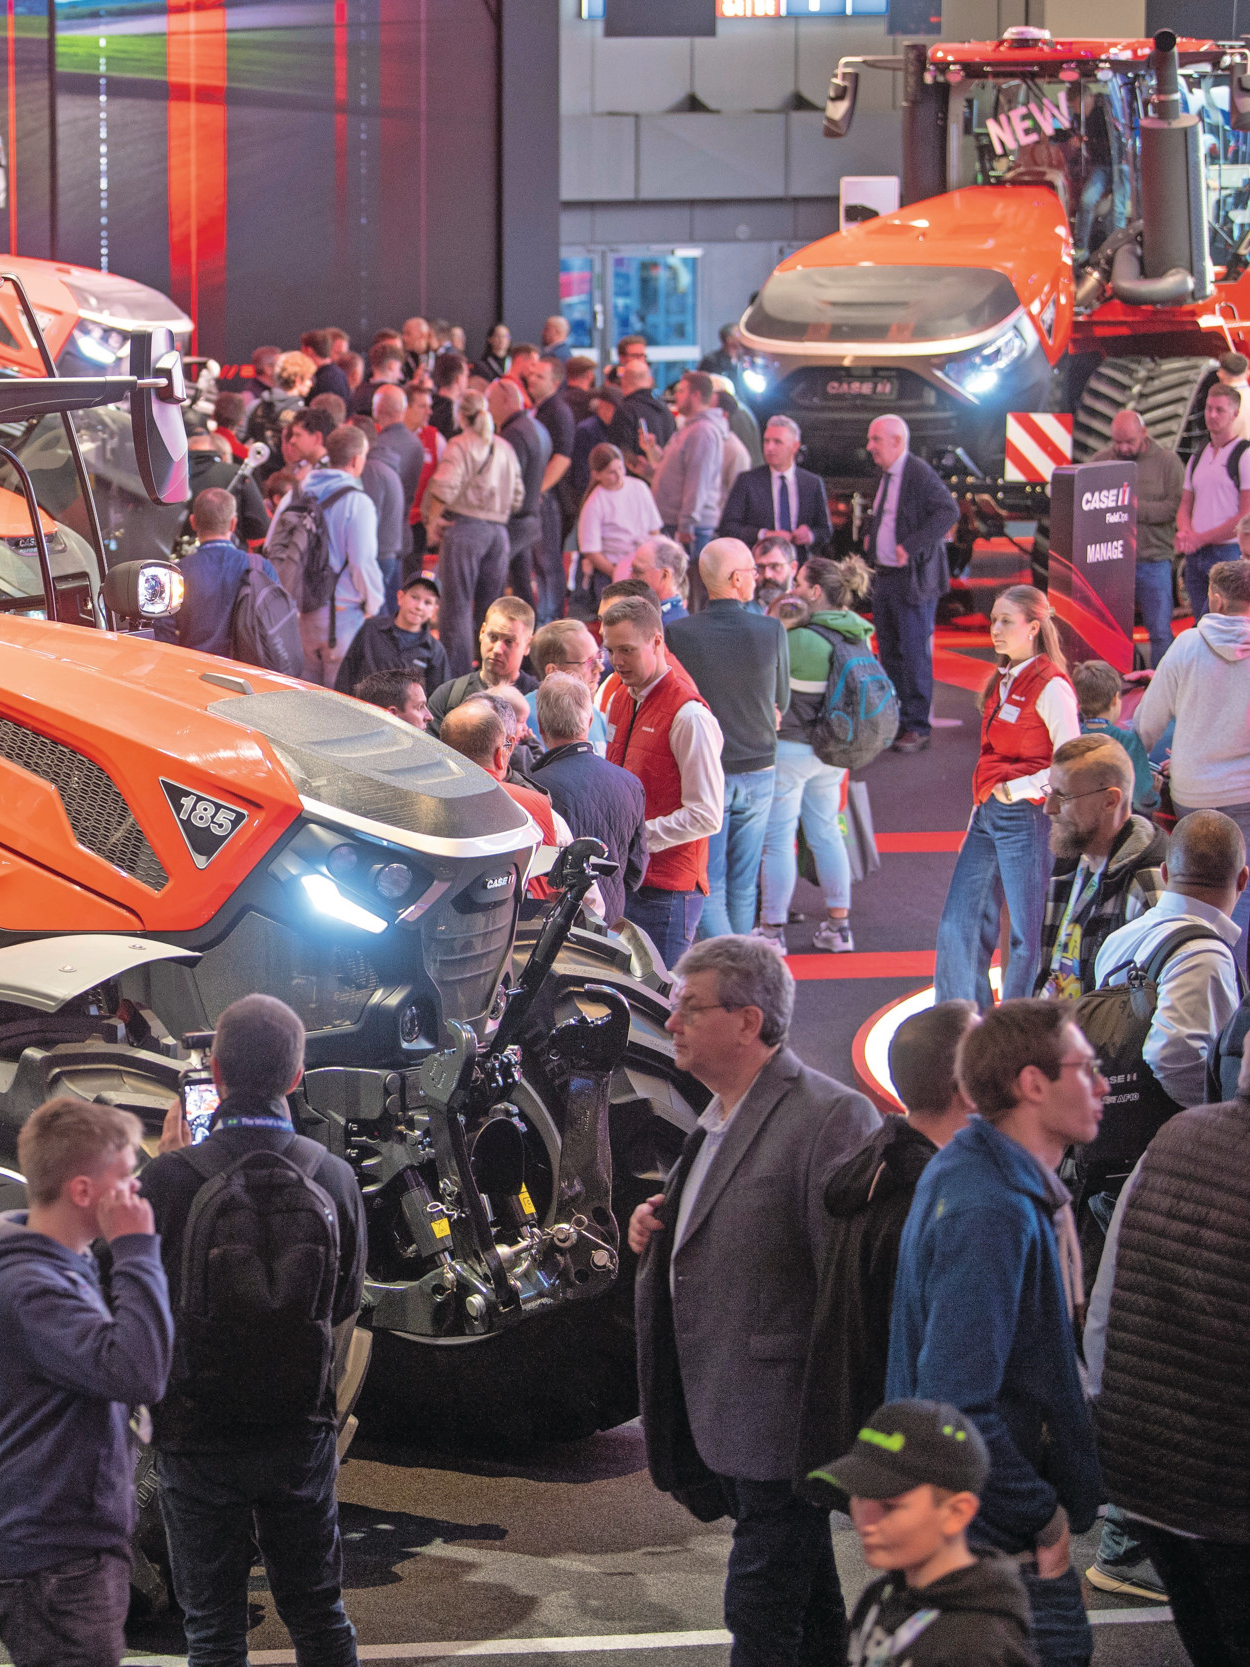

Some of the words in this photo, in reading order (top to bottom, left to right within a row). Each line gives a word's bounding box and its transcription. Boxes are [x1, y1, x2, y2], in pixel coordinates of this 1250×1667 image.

[986, 90, 1071, 156] NEW
[826, 381, 873, 395] CASE
[1081, 488, 1118, 511] CASE
[1105, 511, 1129, 524] FieldOps
[1086, 540, 1124, 564] MANAGE
[179, 794, 237, 836] 185
[486, 876, 508, 889] CASE
